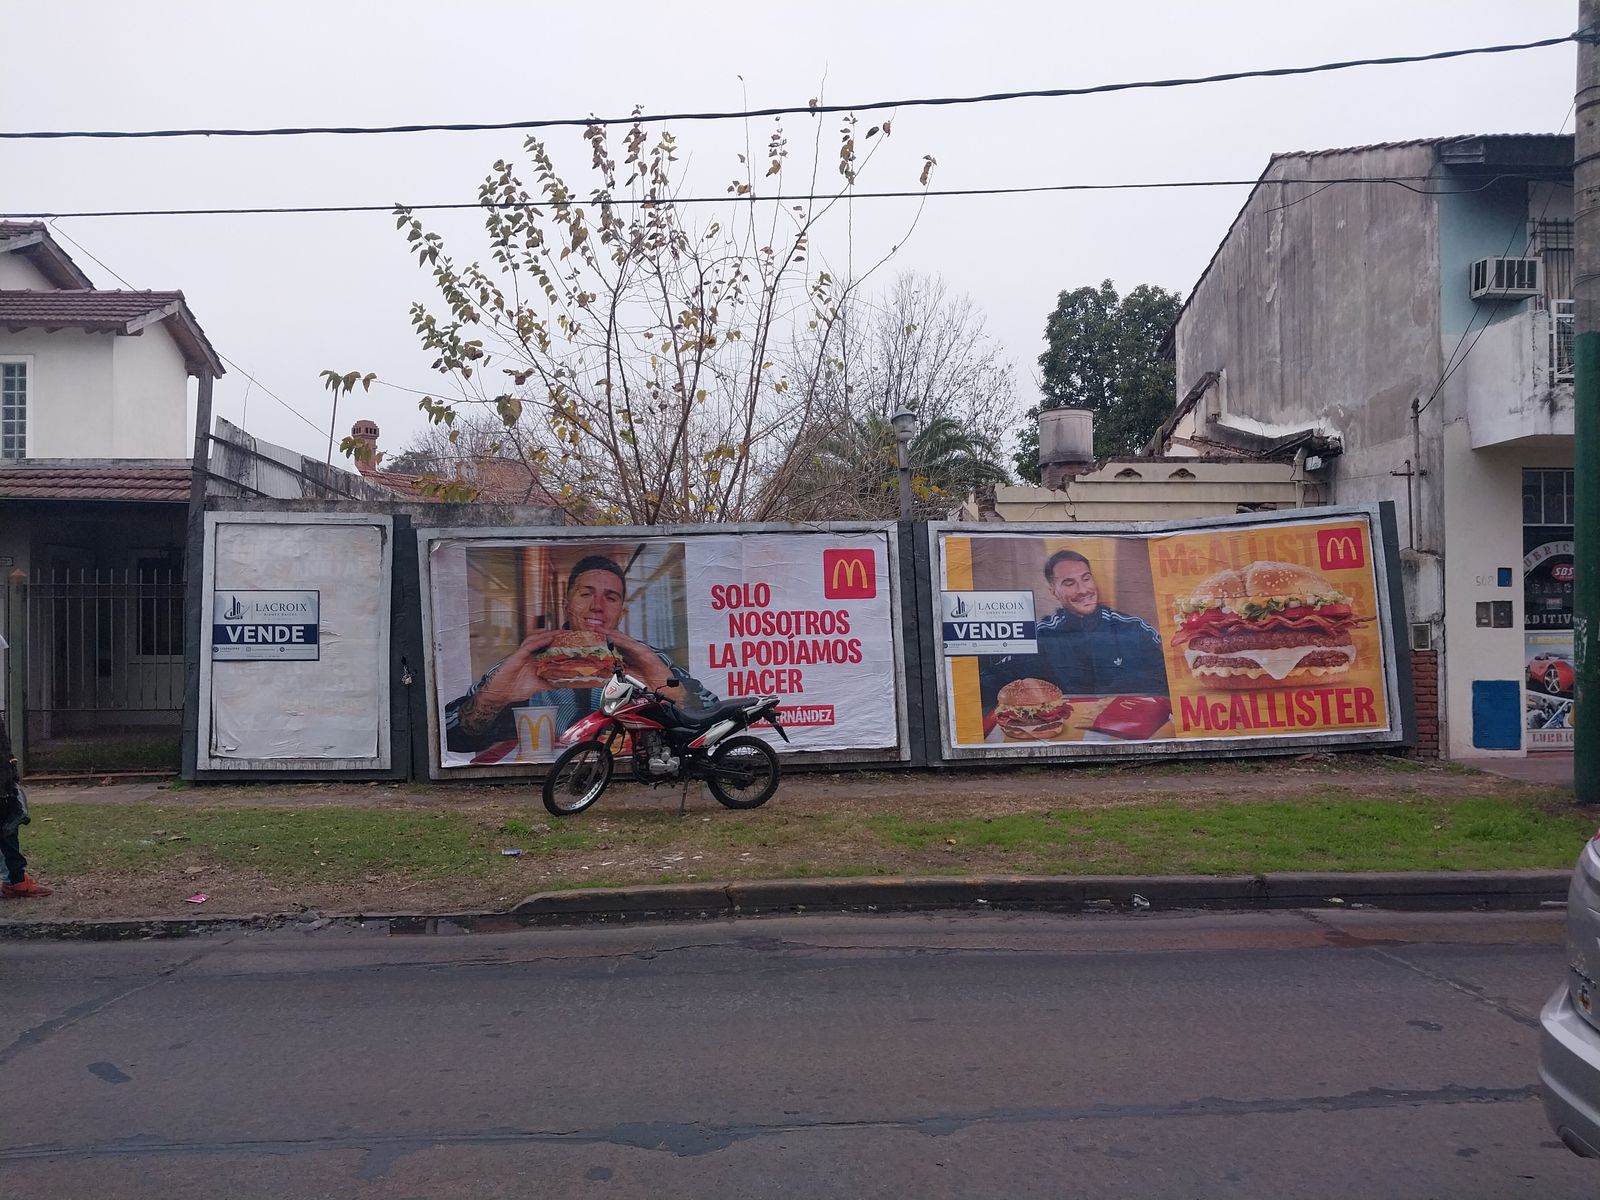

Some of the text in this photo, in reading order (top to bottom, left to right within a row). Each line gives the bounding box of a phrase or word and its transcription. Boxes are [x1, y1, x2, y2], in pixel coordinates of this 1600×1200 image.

[255, 603, 307, 612] LACROIX
[711, 582, 771, 610] SOLO
[978, 602, 1025, 611] LACROIX
[225, 626, 305, 643] VENDE
[728, 610, 850, 638] NOSOTROS
[952, 622, 1025, 639] VENDE
[708, 633, 863, 669] LA PODÍAMOS
[727, 668, 804, 697] HACER
[1179, 686, 1377, 732] McALLISTER
